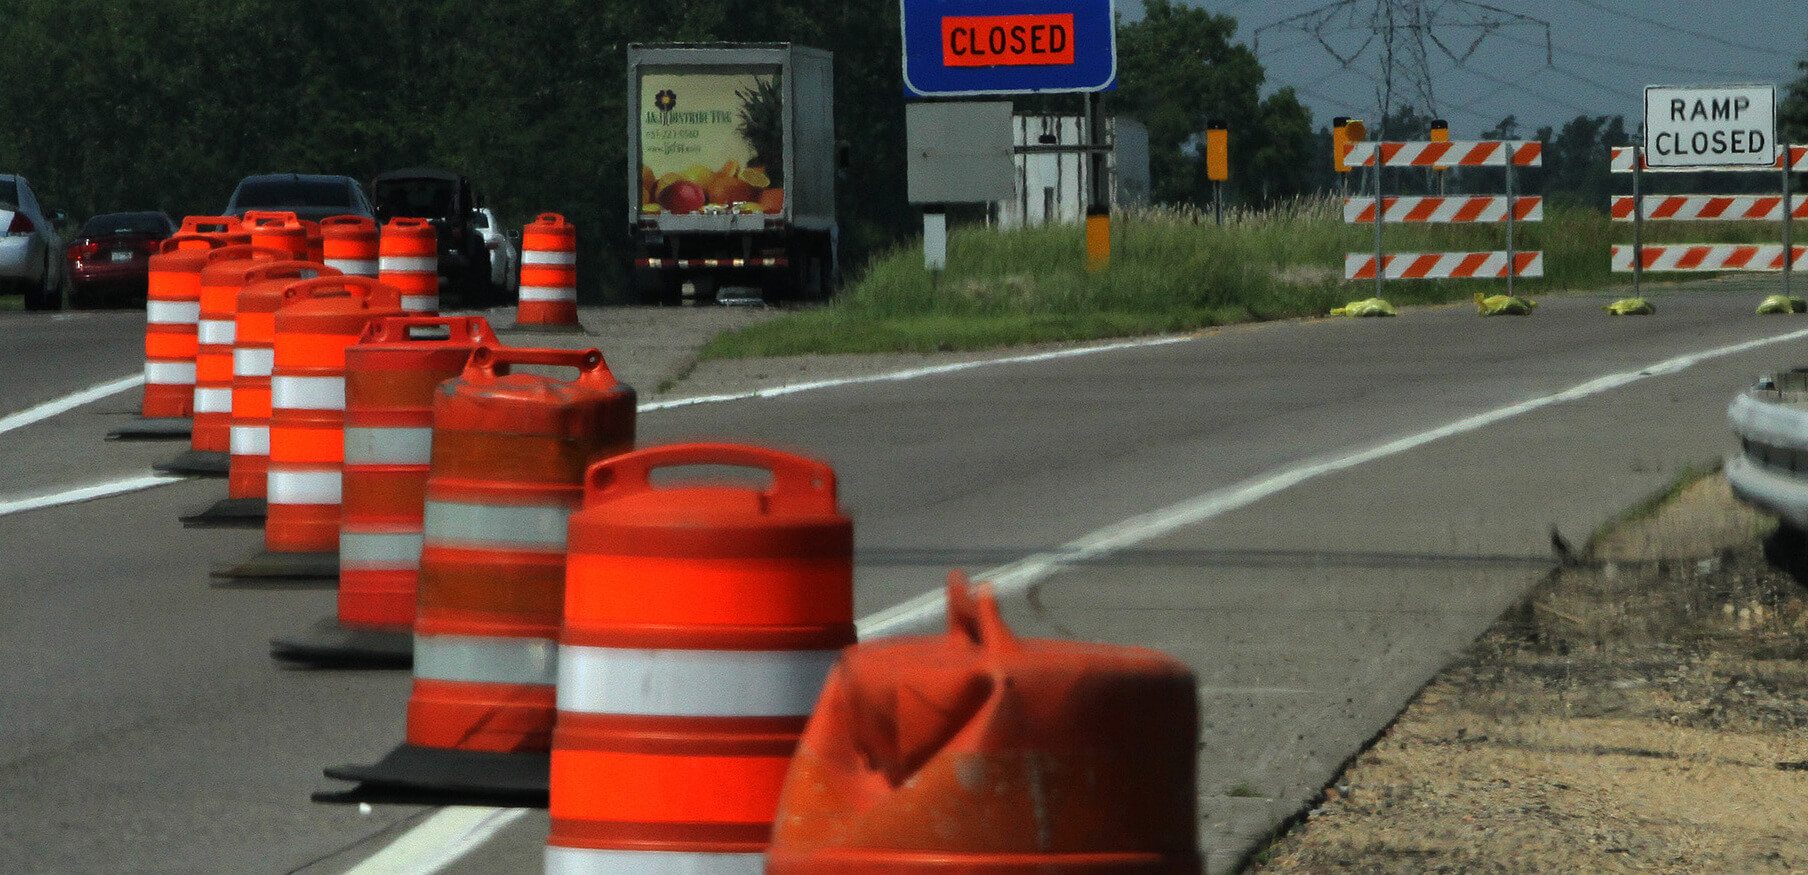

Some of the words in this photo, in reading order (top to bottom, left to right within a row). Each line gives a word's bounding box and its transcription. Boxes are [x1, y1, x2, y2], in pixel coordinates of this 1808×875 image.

[950, 24, 1066, 56] CLOSED
[1670, 96, 1750, 121] RAMP
[1655, 129, 1765, 156] CLOSED
